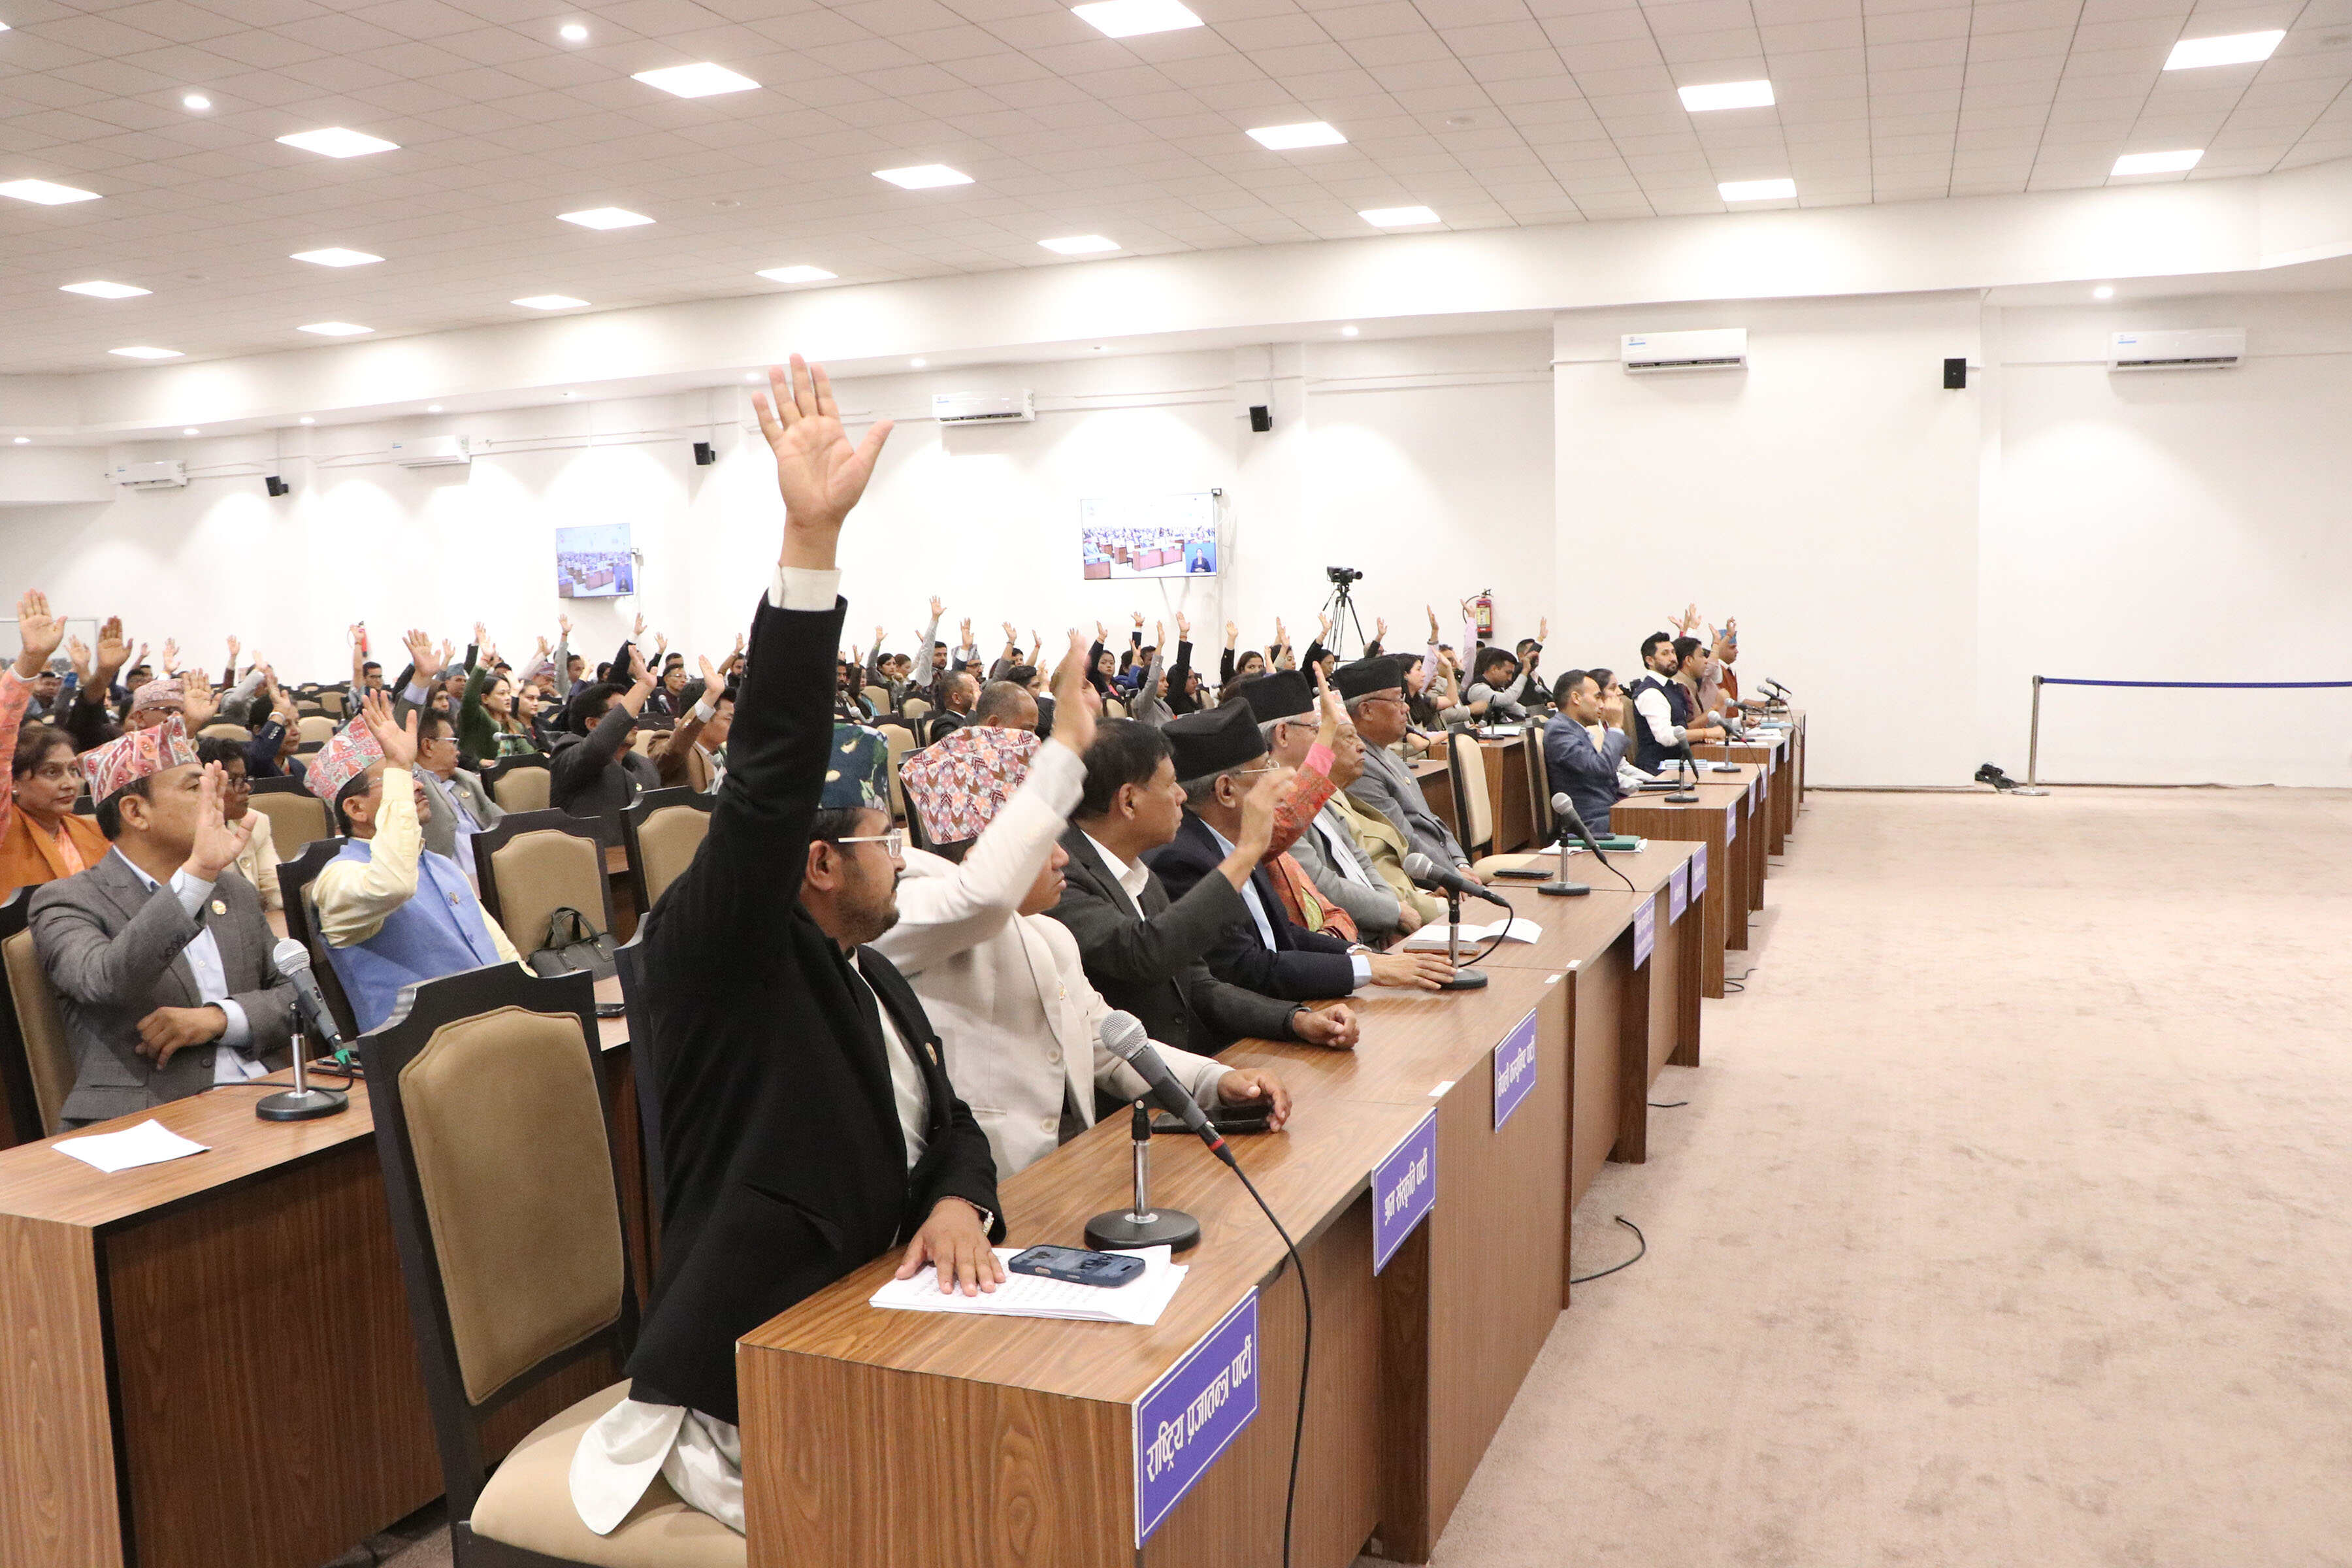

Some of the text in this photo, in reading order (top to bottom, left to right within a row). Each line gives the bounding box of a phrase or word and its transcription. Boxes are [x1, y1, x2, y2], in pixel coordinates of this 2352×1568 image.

[1416, 1147, 1428, 1185] पार्टी
[1146, 1334, 1252, 1483] राष्ट्रिय प्रजातन्त्र पार्टी
